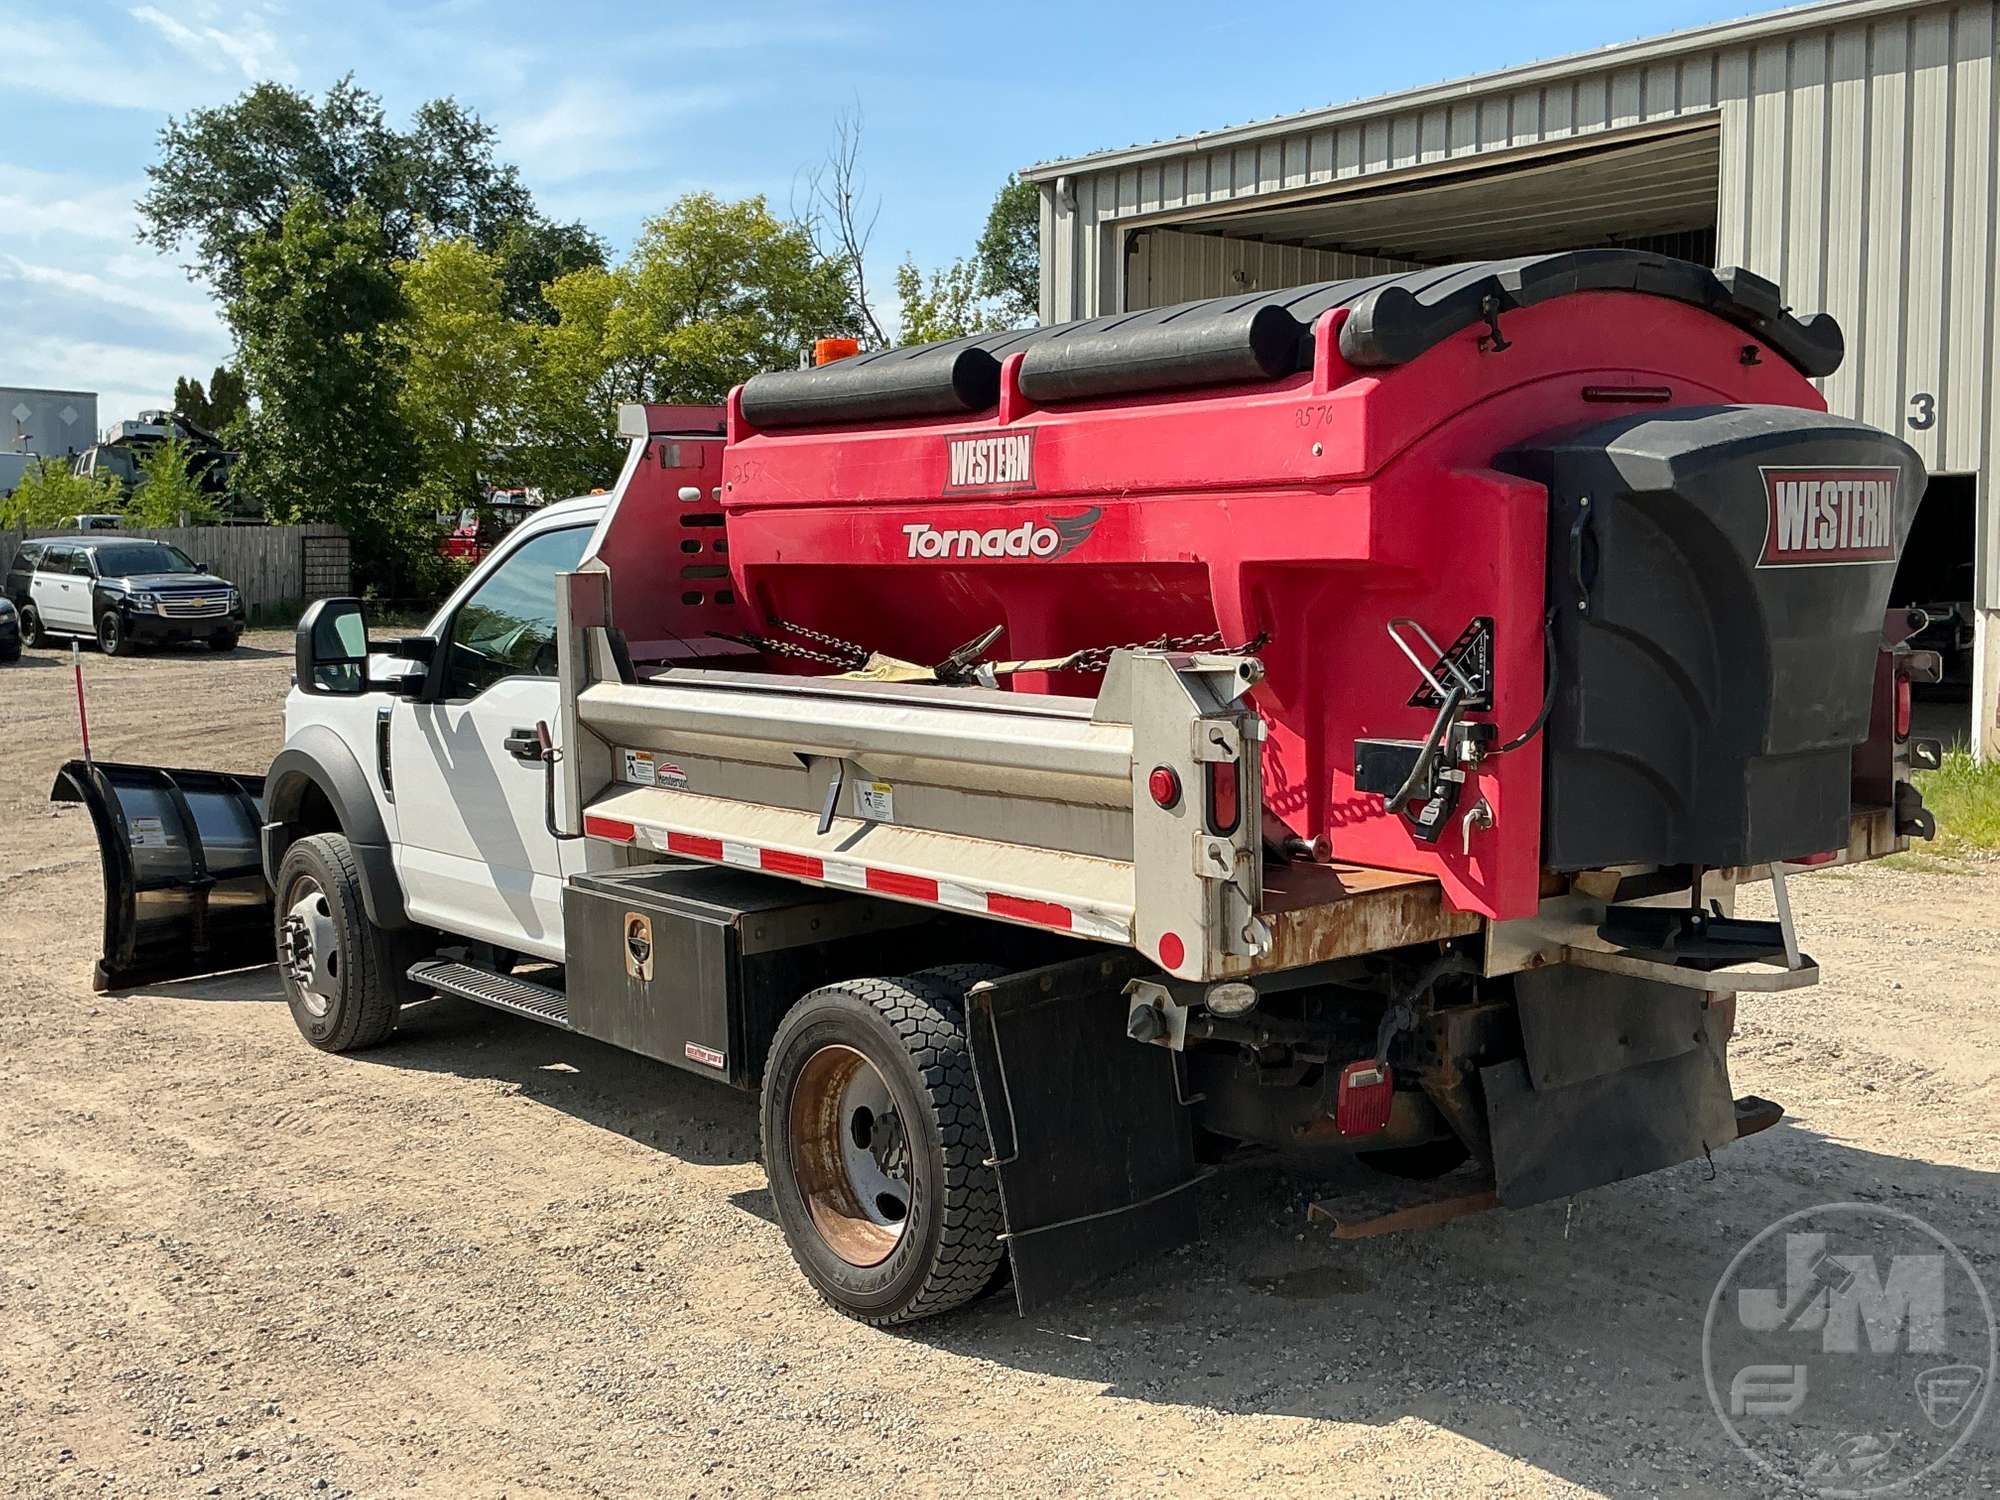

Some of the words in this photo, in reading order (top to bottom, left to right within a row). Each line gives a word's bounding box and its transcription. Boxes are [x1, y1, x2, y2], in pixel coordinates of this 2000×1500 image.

[1907, 392, 1936, 431] 3
[951, 434, 1030, 486] WESTERN
[1775, 481, 1892, 551] WESTERN
[903, 522, 1059, 558] Tornado
